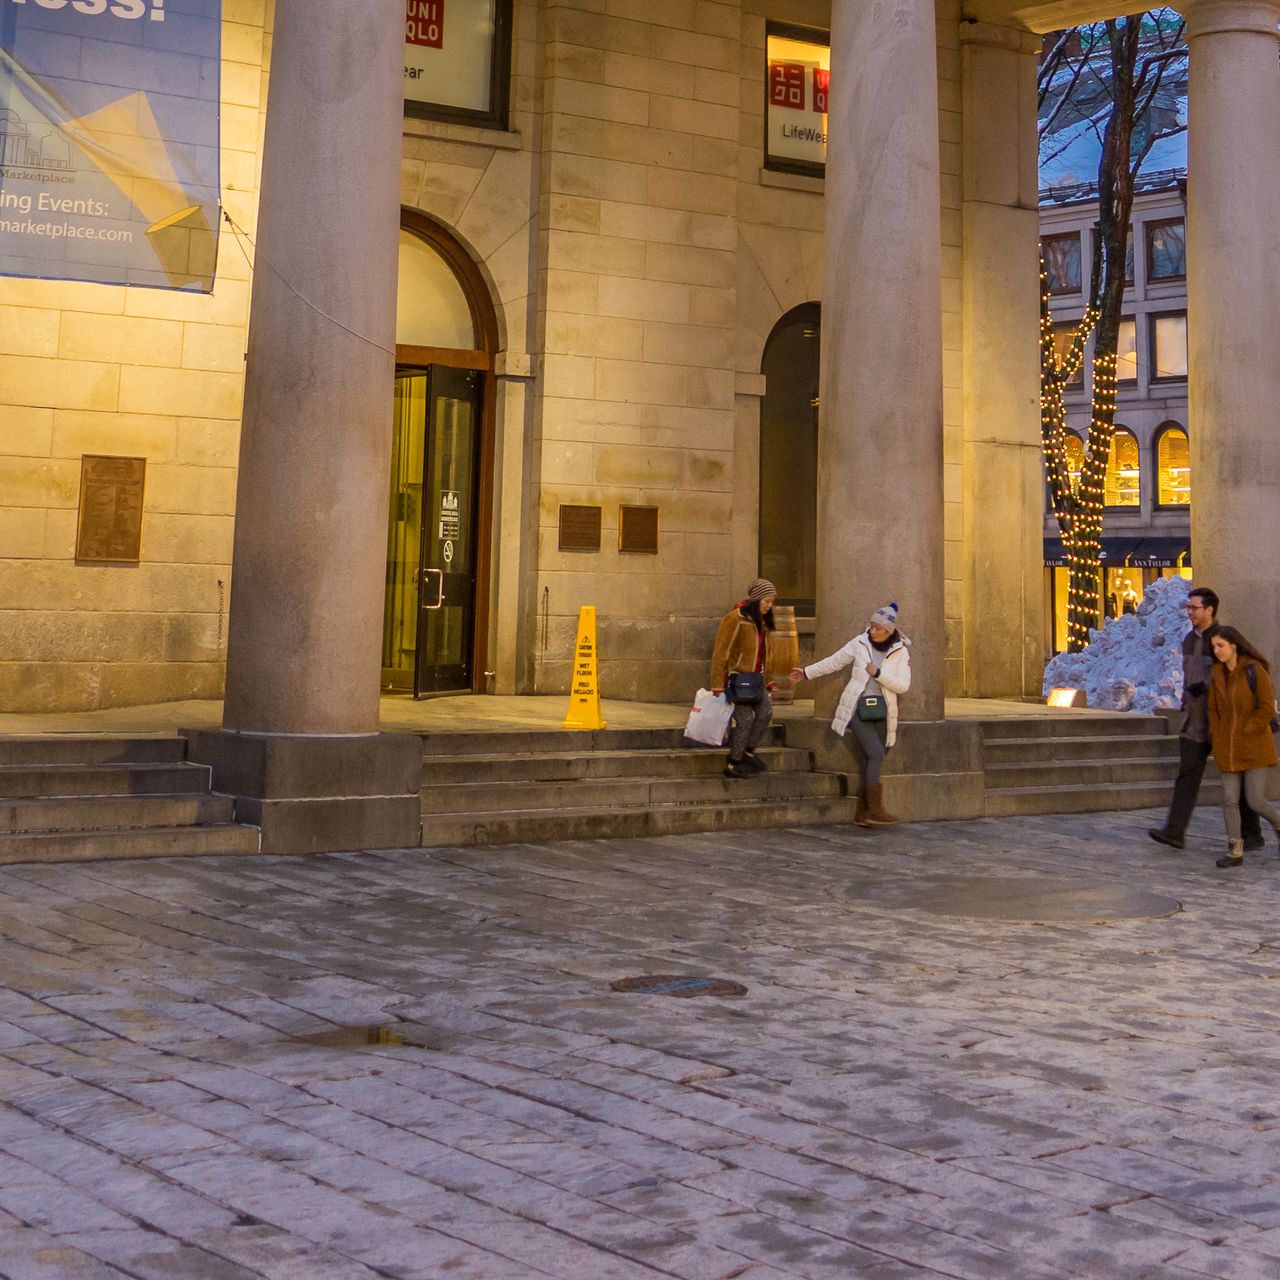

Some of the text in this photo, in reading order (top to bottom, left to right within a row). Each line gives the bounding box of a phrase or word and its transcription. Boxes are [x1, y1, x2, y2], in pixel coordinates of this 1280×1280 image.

[407, 0, 437, 21] UNI
[406, 20, 439, 41] QLO
[782, 123, 828, 144] LifeWea
[37, 192, 110, 216] Events:
